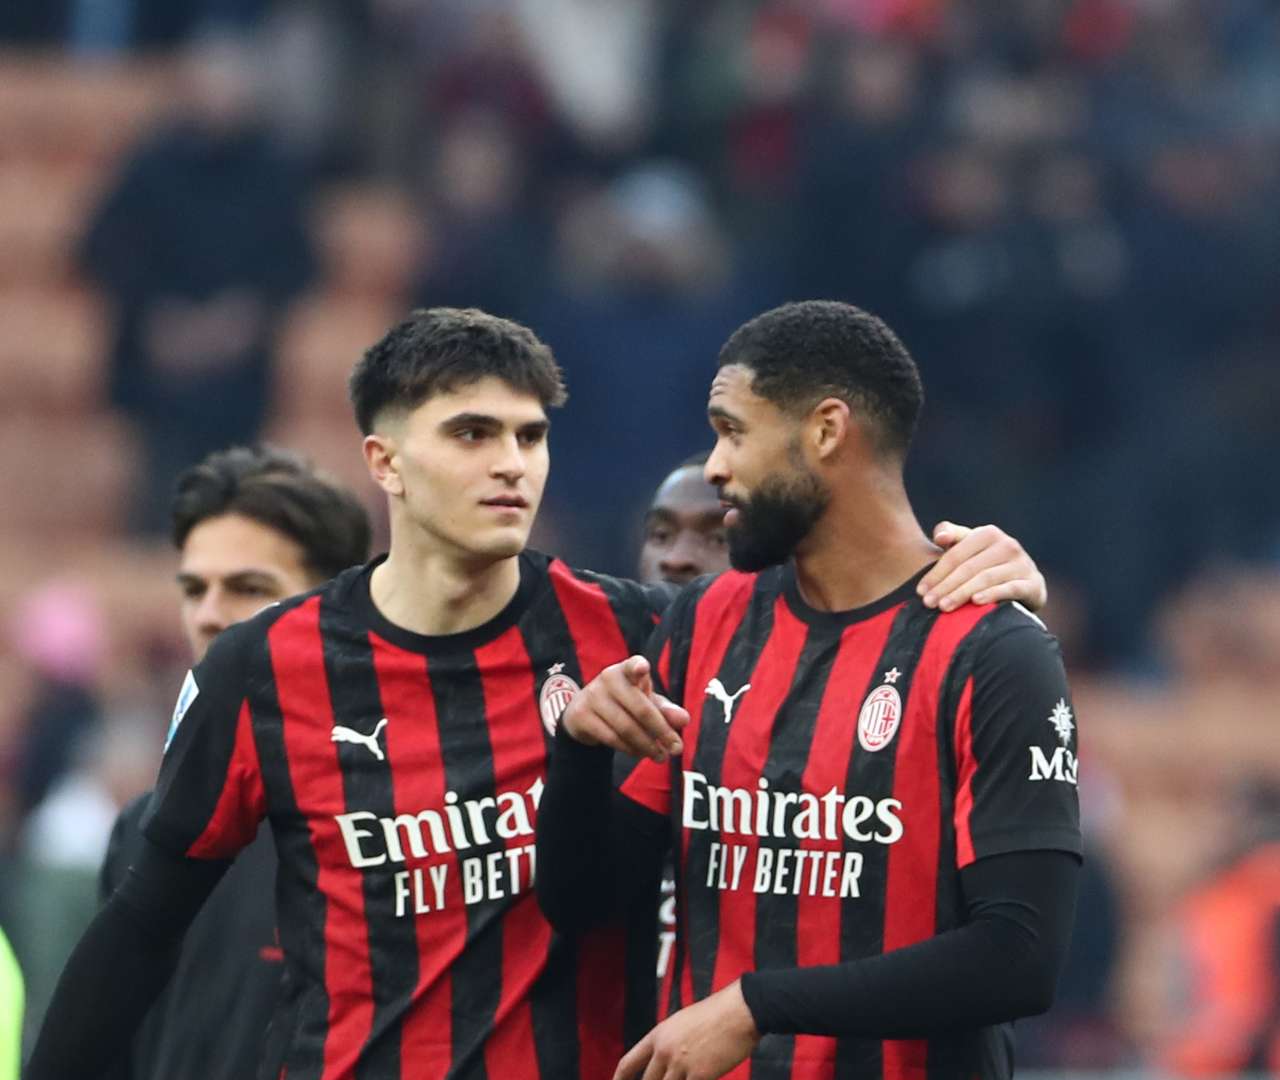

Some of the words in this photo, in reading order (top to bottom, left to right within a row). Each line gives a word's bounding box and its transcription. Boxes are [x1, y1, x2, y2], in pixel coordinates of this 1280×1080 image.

[682, 770, 904, 844] Emirates
[394, 864, 449, 917] FLY
[706, 842, 748, 891] FLY
[753, 847, 864, 898] BETTER
